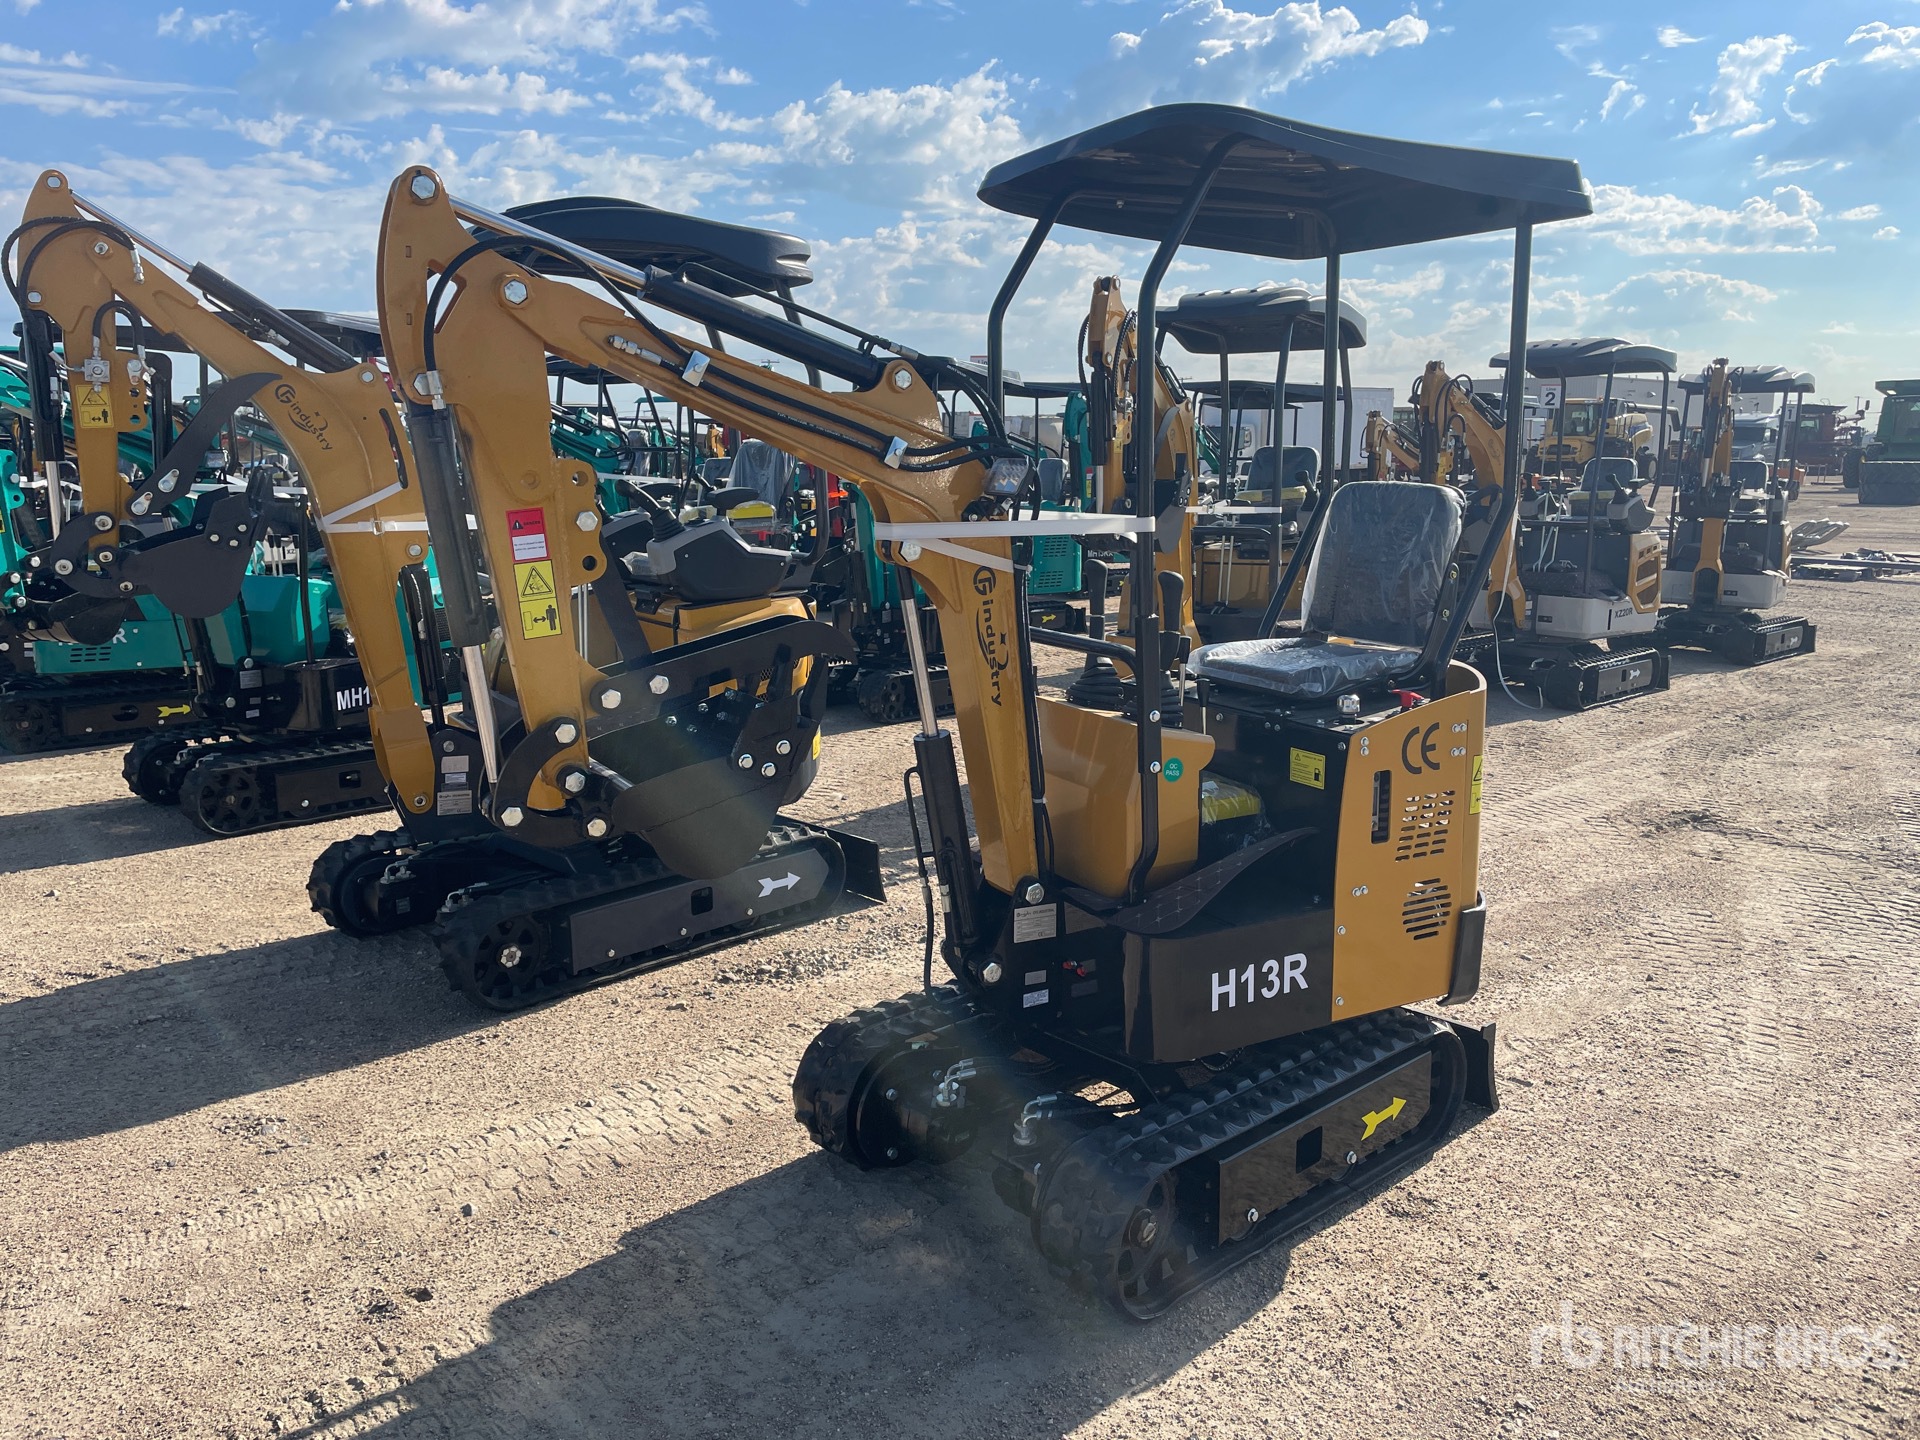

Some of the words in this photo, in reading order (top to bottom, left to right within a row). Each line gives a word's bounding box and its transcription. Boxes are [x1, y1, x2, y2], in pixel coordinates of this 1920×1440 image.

[1544, 391, 1556, 406] 2
[1614, 607, 1633, 619] XZ20R
[336, 686, 370, 710] MH1
[1402, 722, 1440, 774] CE
[1211, 953, 1309, 1012] H13R
